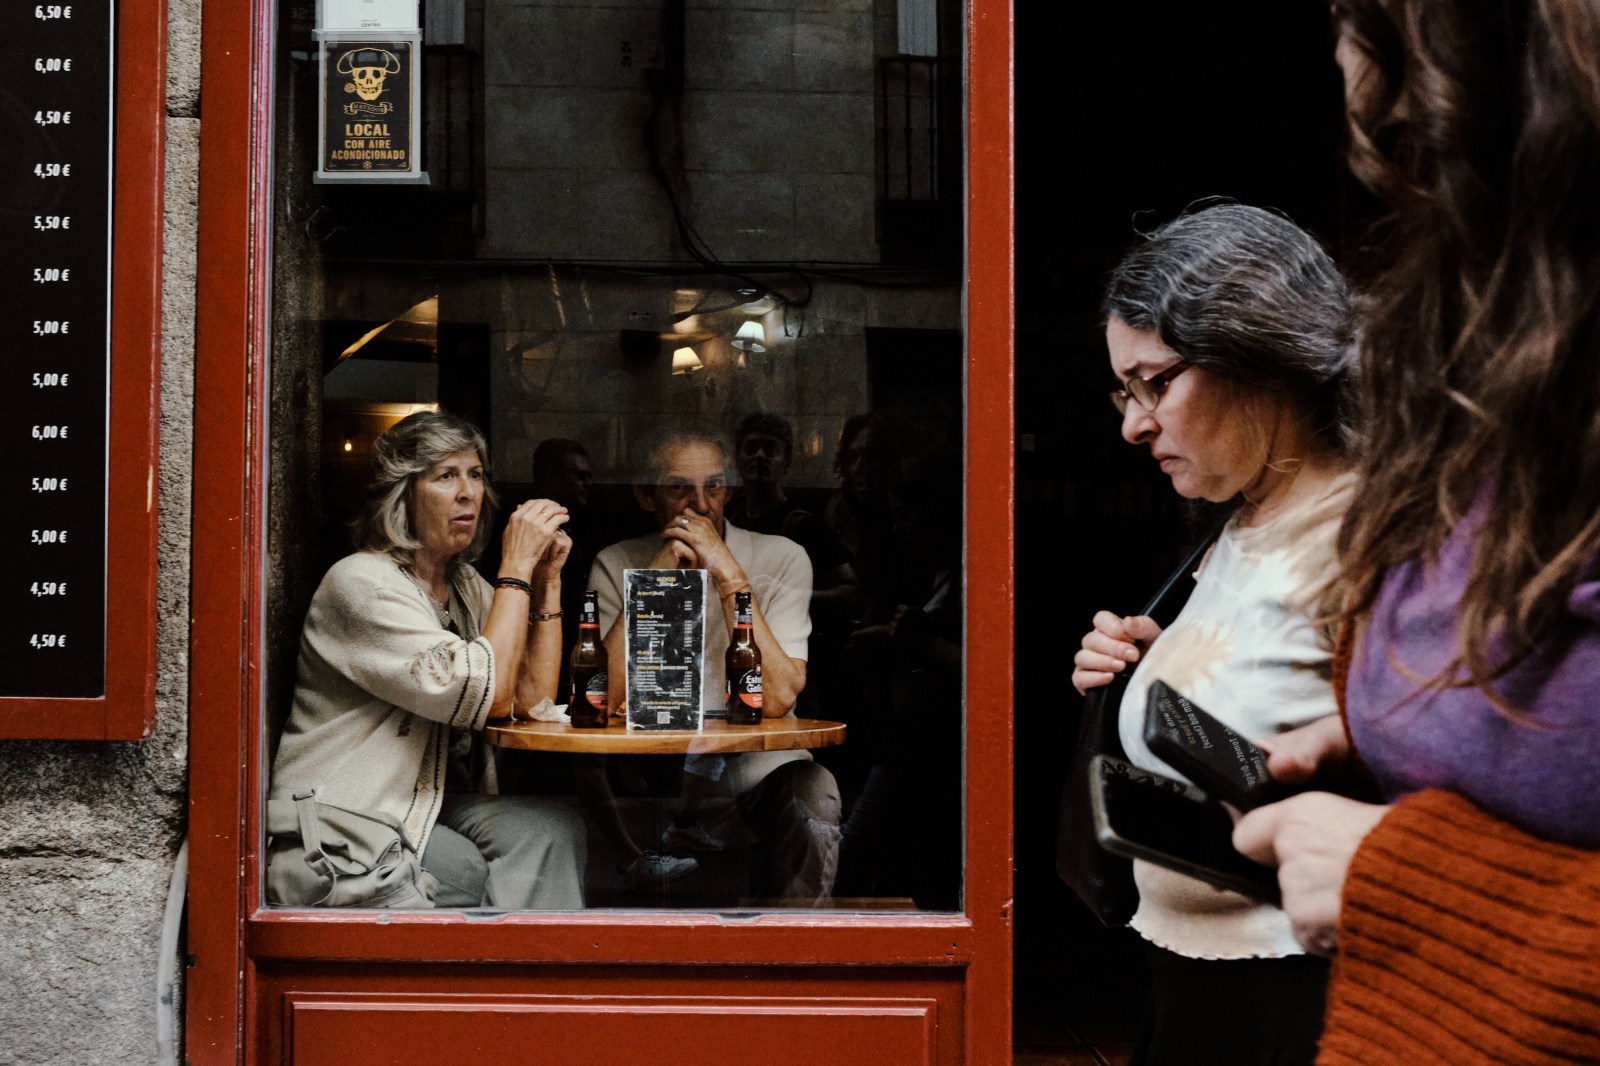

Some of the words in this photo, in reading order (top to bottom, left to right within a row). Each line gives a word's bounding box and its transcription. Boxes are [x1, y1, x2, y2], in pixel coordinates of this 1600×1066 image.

[345, 124, 390, 136] LOCAL
[345, 139, 365, 149] CON
[368, 139, 391, 149] AIRE
[331, 150, 406, 160] ACONDICIONADO
